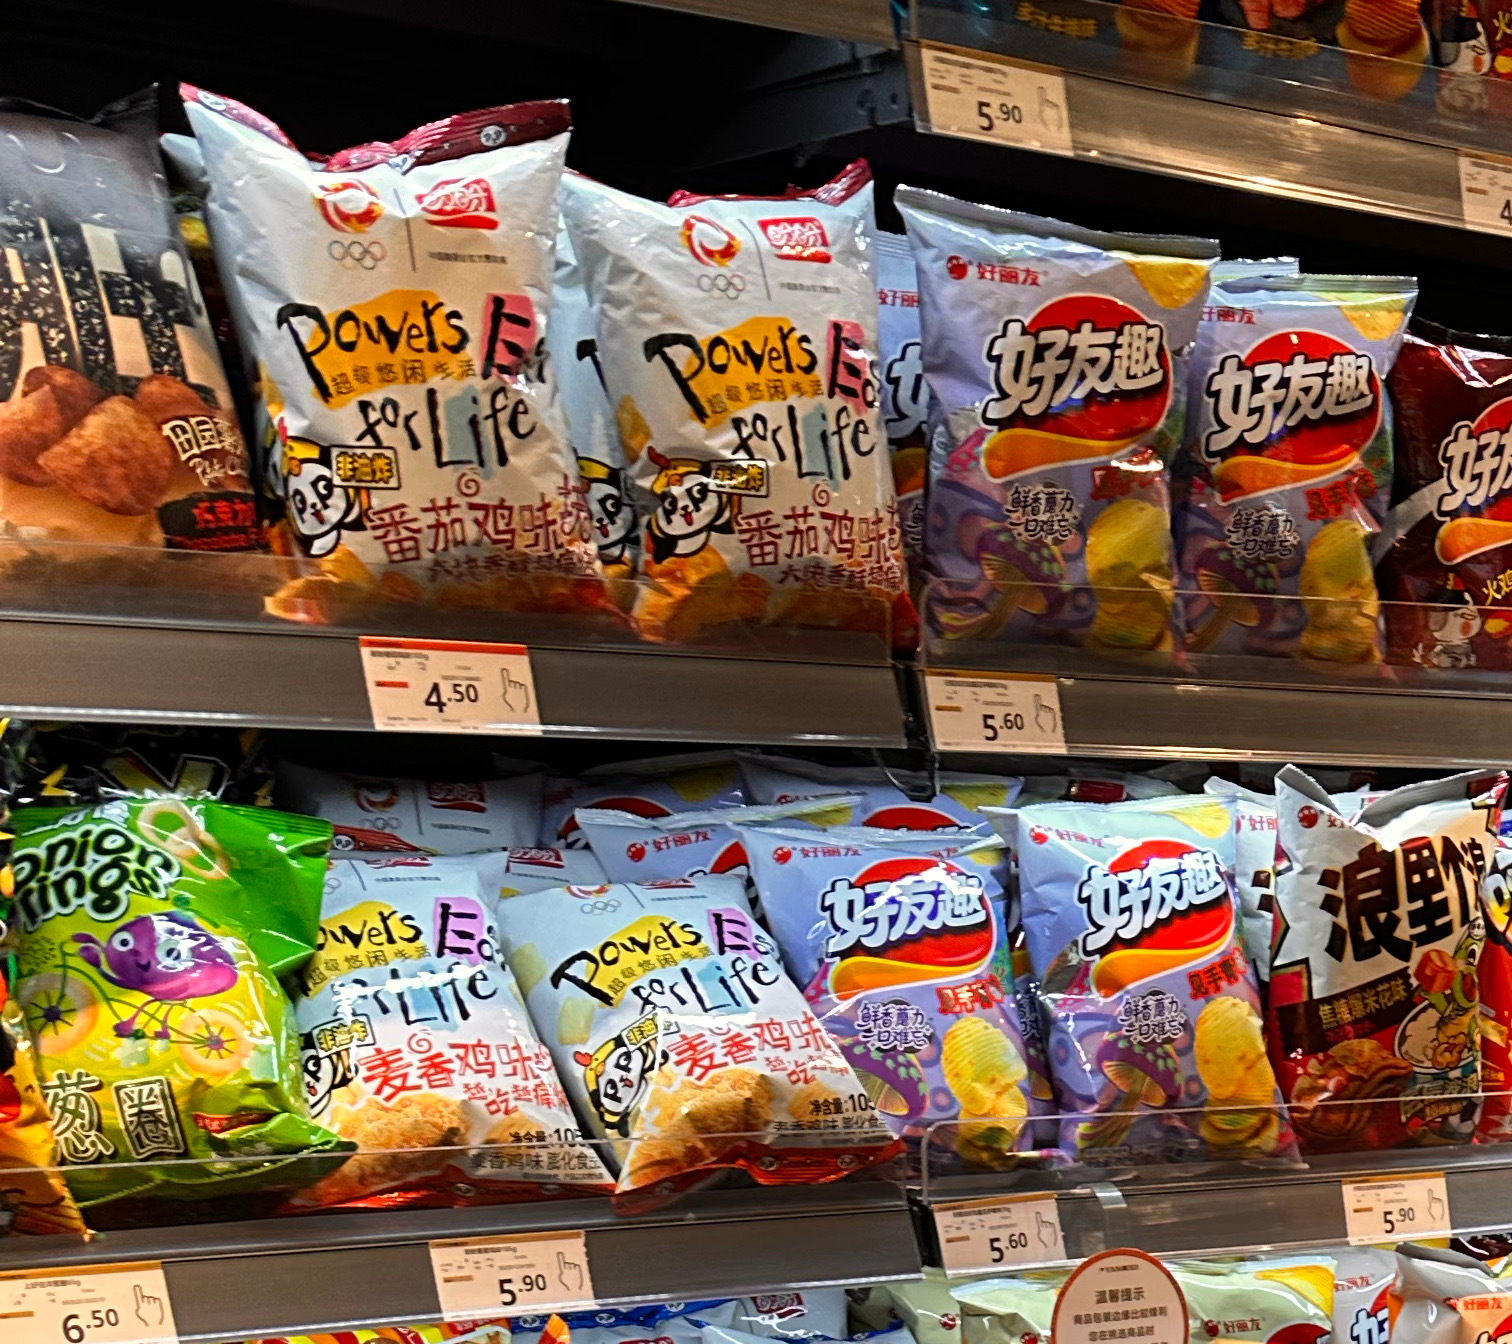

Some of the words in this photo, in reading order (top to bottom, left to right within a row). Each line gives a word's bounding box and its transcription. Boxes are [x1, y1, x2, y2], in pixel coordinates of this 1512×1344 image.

[978, 100, 1023, 132] 5.90
[976, 262, 1042, 287] 好丽友
[277, 299, 470, 400] Powers
[329, 358, 478, 396] 超级悠闲生活
[643, 323, 819, 421] Powers
[982, 319, 1166, 425] 好友趣
[706, 377, 825, 415] 超级悠闲生活
[1206, 353, 1375, 456] 好友趣
[356, 397, 421, 449] for
[428, 388, 538, 468] Life
[730, 412, 787, 462] for
[787, 404, 876, 481] Life
[335, 451, 395, 484] 非油炸
[424, 681, 479, 714] 4.50
[982, 710, 1025, 743] 5.60
[653, 830, 710, 850] 好丽友
[822, 872, 988, 953] 好友趣
[1079, 850, 1226, 951] 好友趣
[309, 945, 432, 989] 超级悠闲生活
[550, 920, 703, 1007] Powers
[606, 944, 714, 997] 超级悠闲生活
[630, 980, 690, 1019] for
[682, 957, 782, 1014] Life
[666, 1010, 833, 1083] 麦香鸡味
[44, 1069, 190, 1163] 葱圈
[1382, 1205, 1416, 1235] 5.90
[988, 1230, 1029, 1263] 5.60
[498, 1273, 548, 1307] 5.90
[1095, 1286, 1145, 1305] 温馨提示
[61, 1308, 120, 1344] 6.50
[1222, 1317, 1262, 1334] 好丽友
